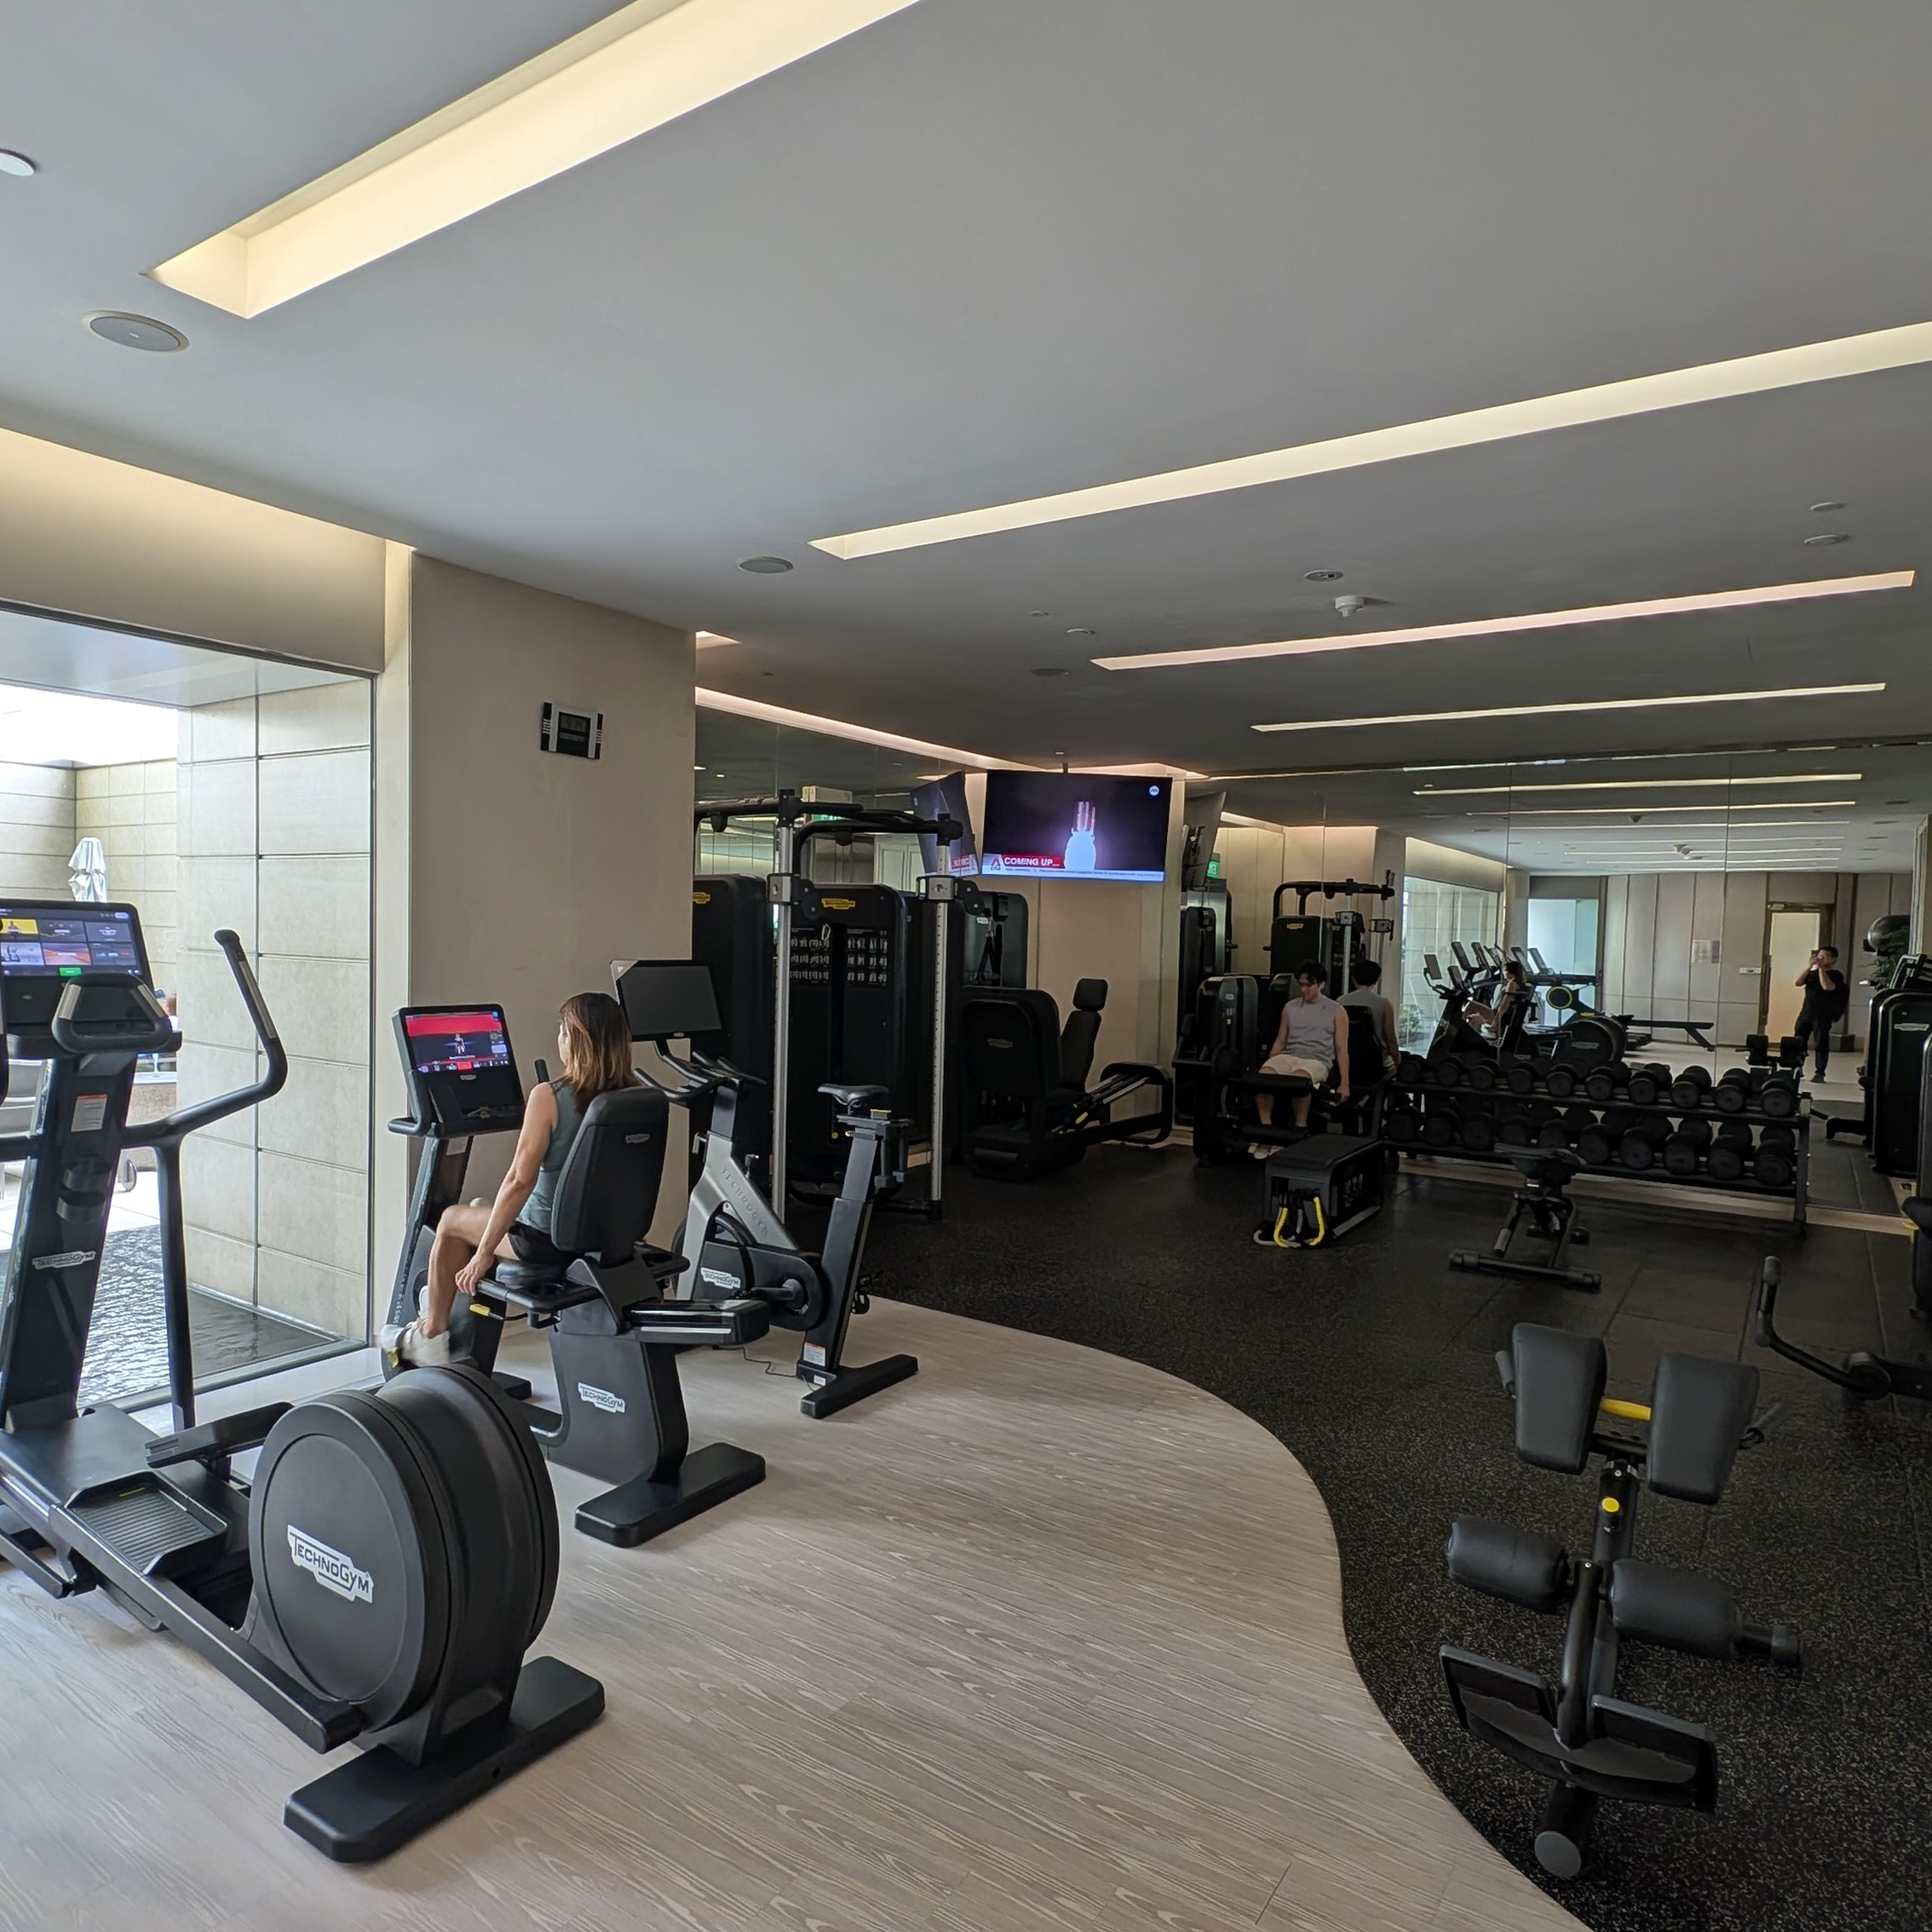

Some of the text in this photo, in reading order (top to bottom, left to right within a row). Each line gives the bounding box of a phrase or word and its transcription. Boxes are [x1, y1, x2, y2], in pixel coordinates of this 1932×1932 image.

[1004, 857, 1038, 865] COMING
[580, 1385, 623, 1408] TECHNOGYM
[290, 1532, 369, 1593] TECHNOGYM
